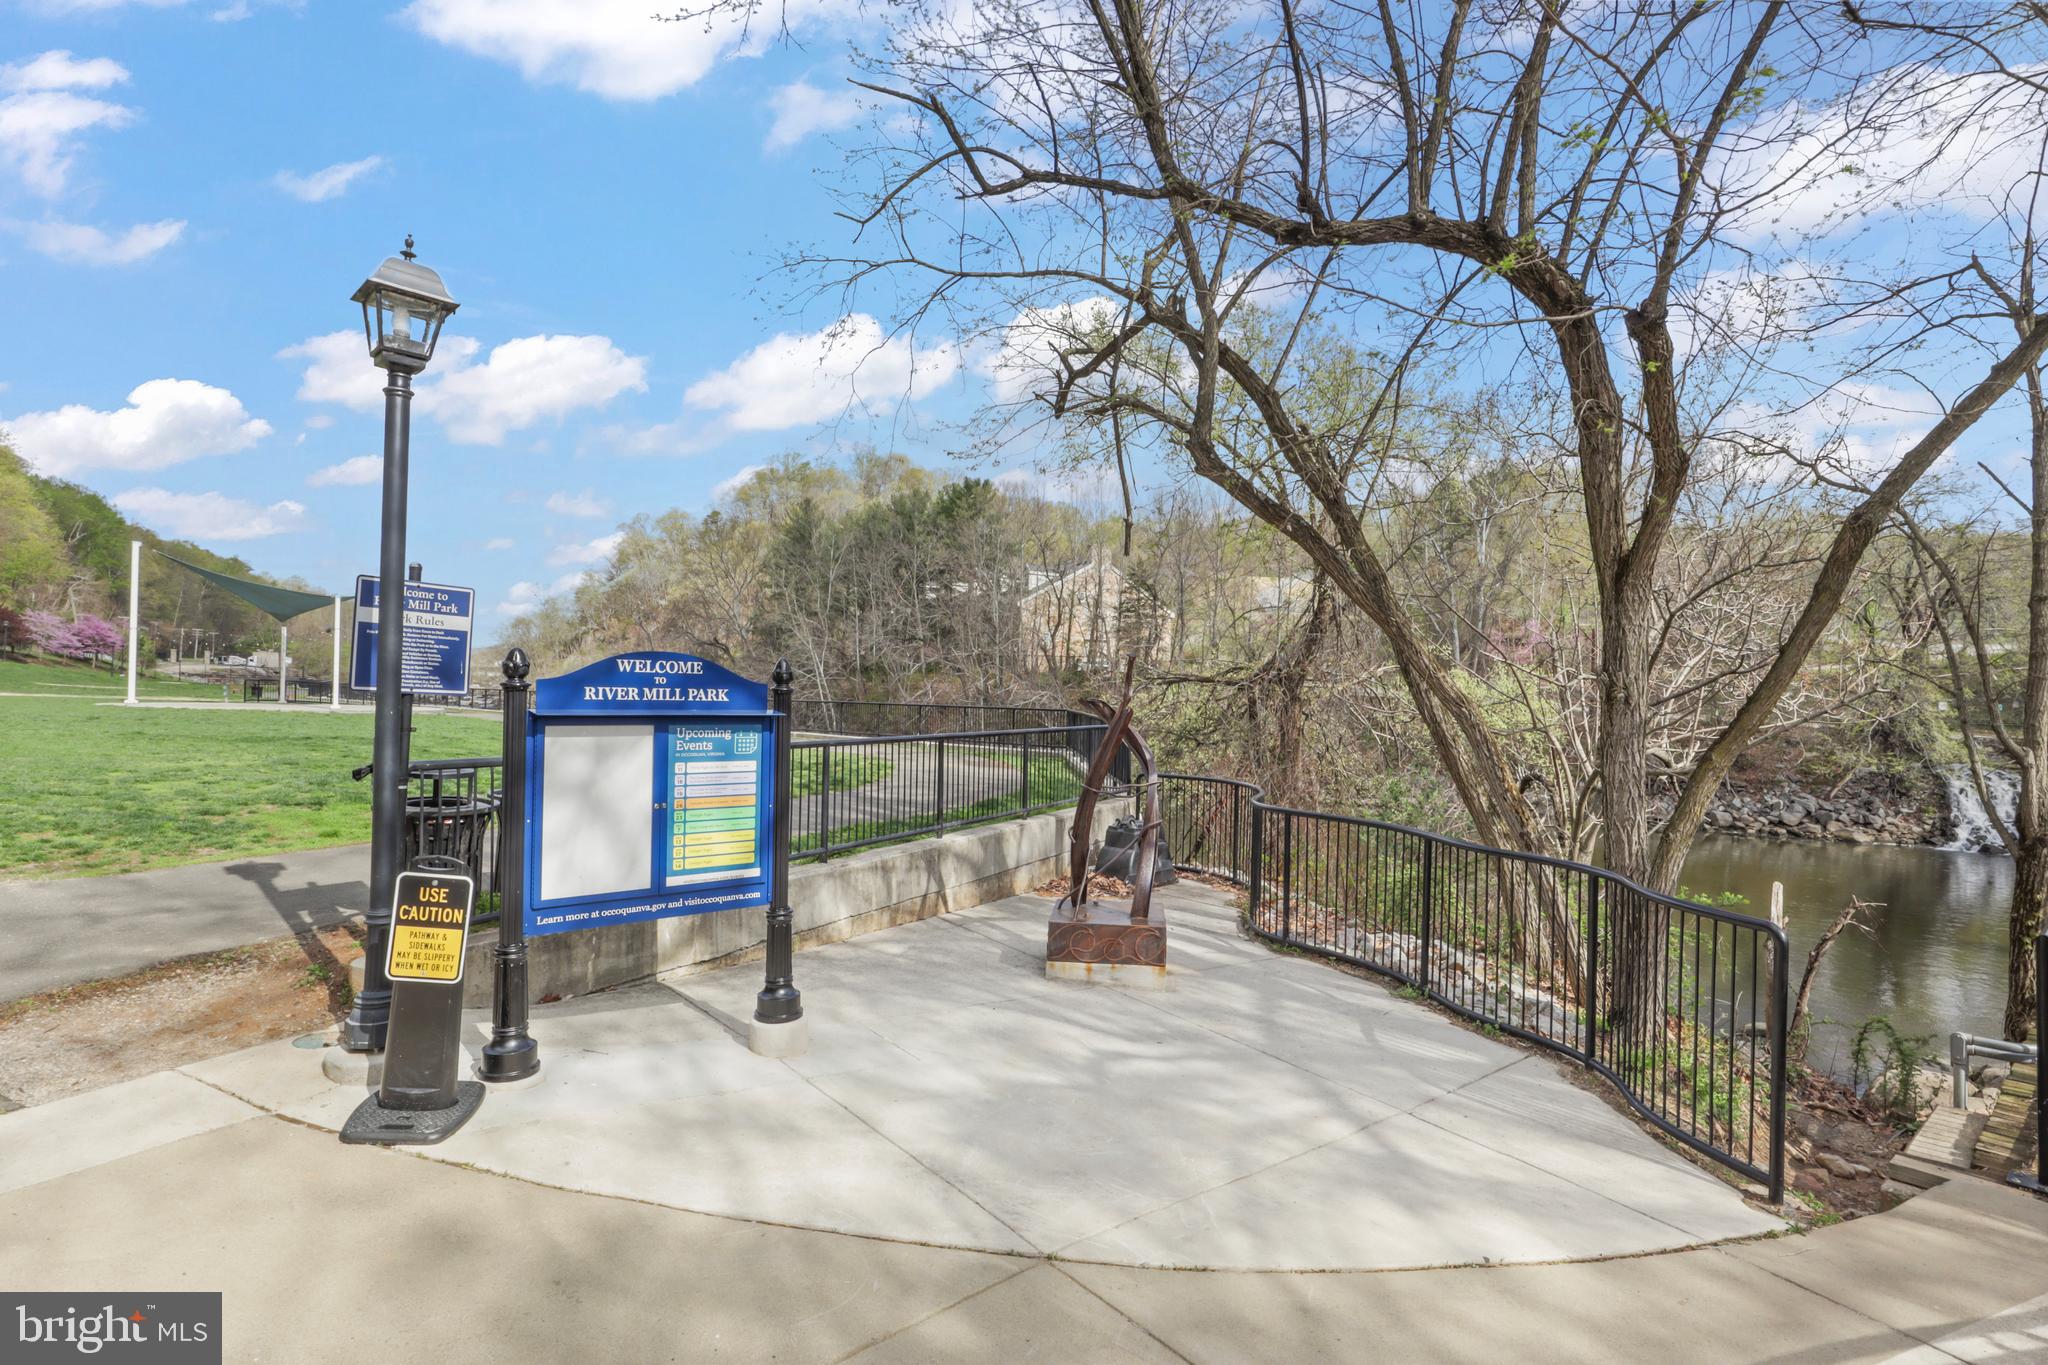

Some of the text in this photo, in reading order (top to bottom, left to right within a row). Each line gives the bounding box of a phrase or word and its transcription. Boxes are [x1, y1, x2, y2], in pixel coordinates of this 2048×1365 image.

[404, 586, 448, 601] lcome to
[408, 599, 458, 614] Mill Park
[416, 615, 445, 626] Rules
[616, 658, 703, 675] WELCOME
[654, 676, 667, 684] TO
[584, 686, 729, 702] RIVER MILL PARK
[676, 727, 732, 740] Upcoming
[676, 740, 713, 751] Events
[419, 886, 449, 903] USE
[399, 905, 464, 924] CAUTION
[536, 891, 761, 926] Learn more at occoquanva.gov and visitoccoquanva.com
[409, 931, 448, 941] PATHWAY &
[409, 941, 446, 951] SIDEWALKS
[396, 951, 455, 962] MAY BE SLIPPERY
[395, 962, 454, 973] WHEN WET OR ICY
